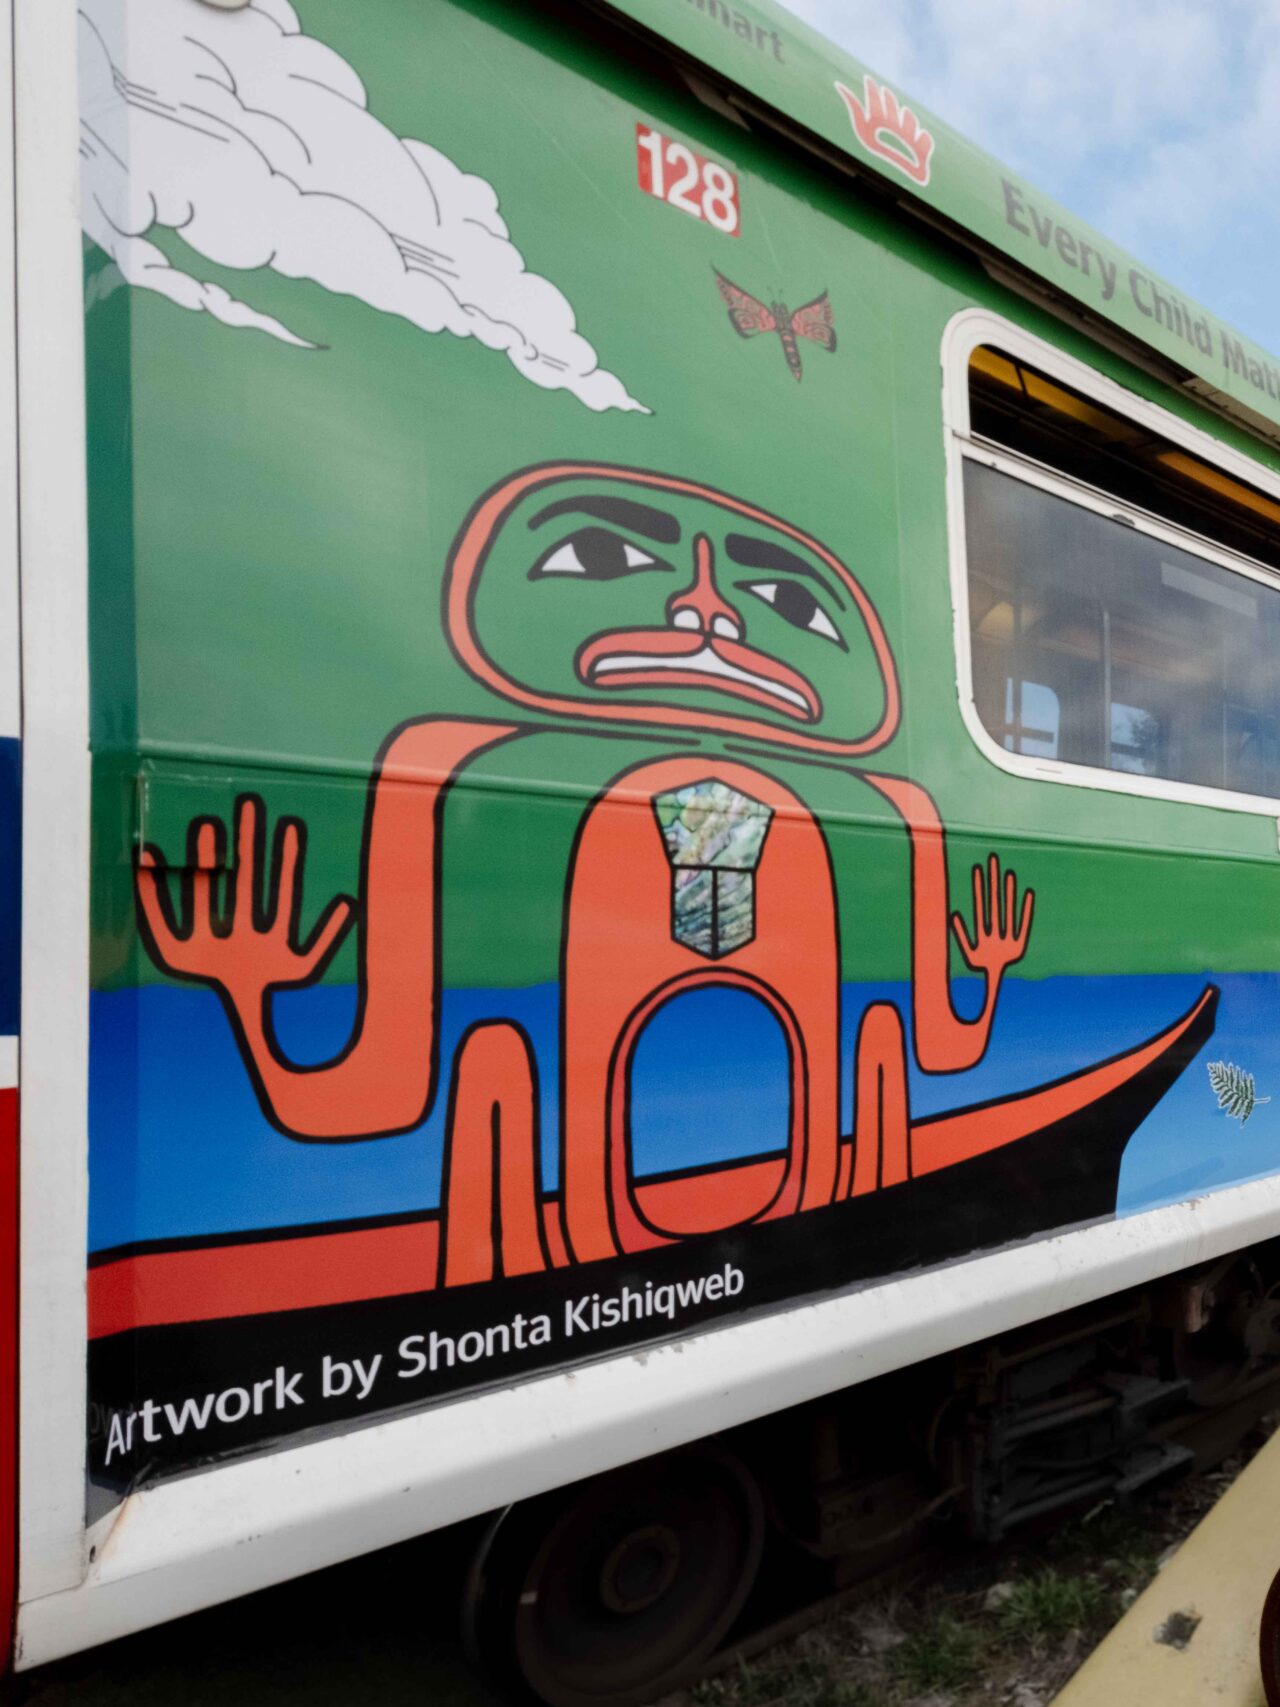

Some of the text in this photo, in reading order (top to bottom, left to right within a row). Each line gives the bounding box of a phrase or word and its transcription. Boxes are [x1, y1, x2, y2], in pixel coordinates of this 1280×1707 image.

[638, 130, 739, 233] 128
[1002, 177, 1117, 301] Every
[1128, 268, 1213, 358] Child
[104, 1365, 304, 1466] Artwork
[322, 1354, 383, 1400] by
[398, 1313, 551, 1379] Shonta
[565, 1263, 745, 1337] Kishiqweb
